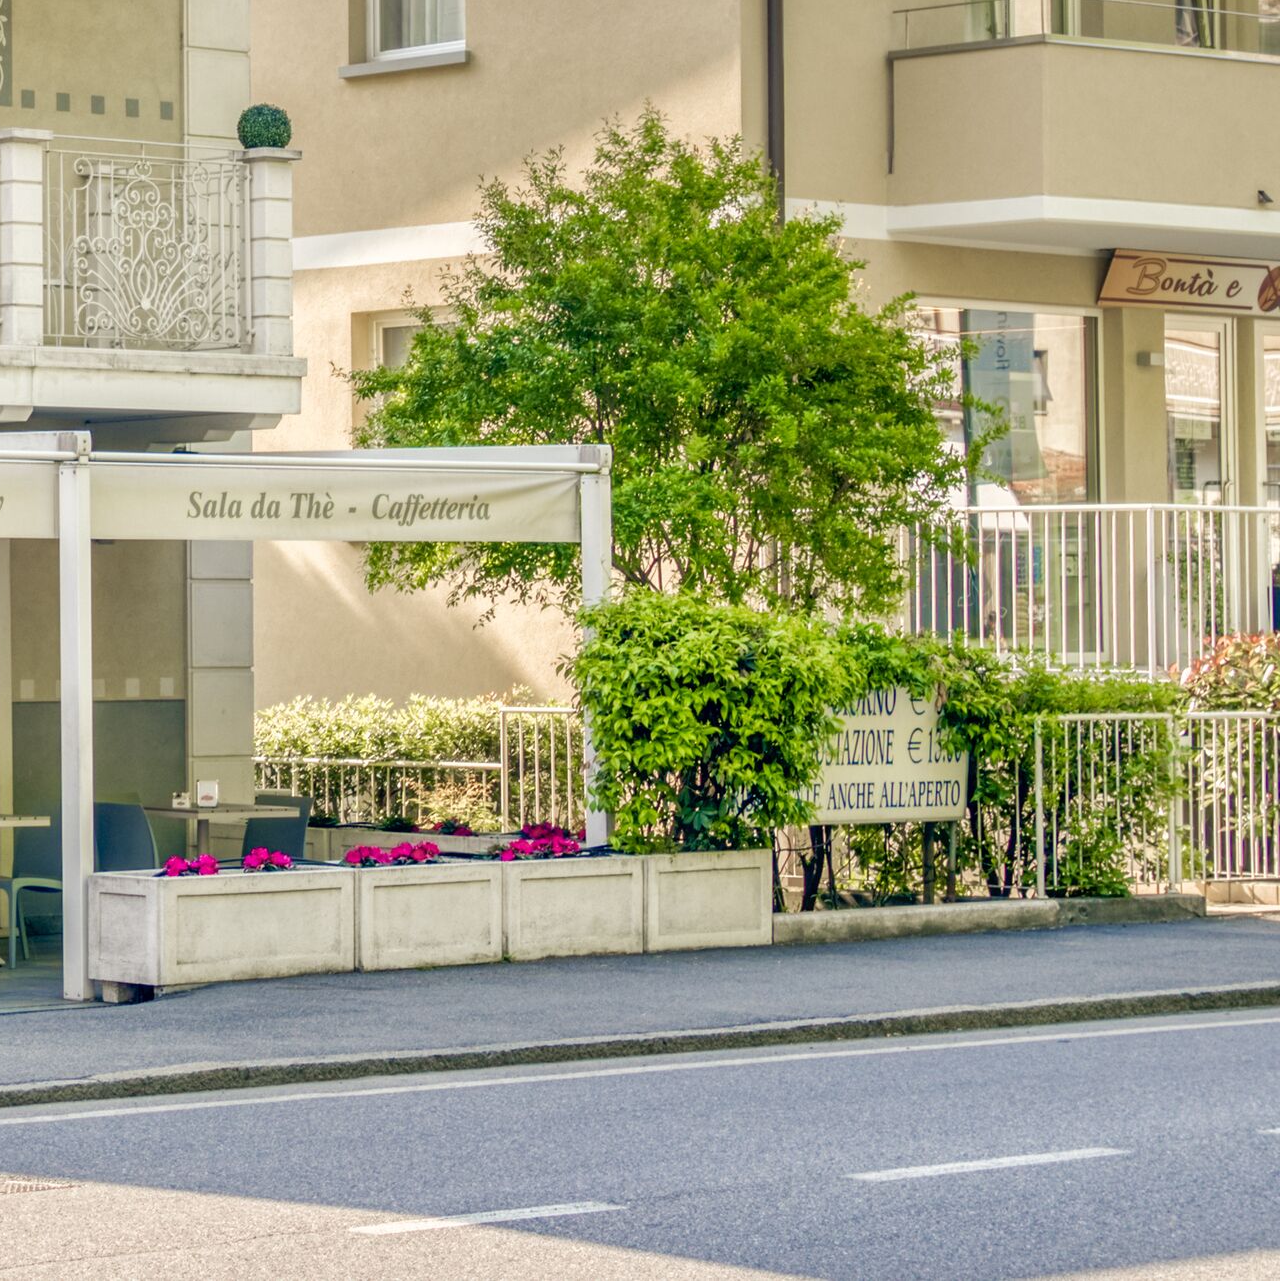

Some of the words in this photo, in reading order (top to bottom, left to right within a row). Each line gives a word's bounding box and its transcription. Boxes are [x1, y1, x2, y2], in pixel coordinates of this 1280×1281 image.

[1126, 257, 1219, 297] Bontà
[1226, 280, 1243, 298] e
[186, 490, 244, 520] Sala
[249, 492, 282, 520] da
[289, 490, 335, 520] Thè
[370, 492, 491, 526] Caffetteria
[827, 782, 875, 810] ANCHE
[879, 780, 961, 809] ALL'APERTO
